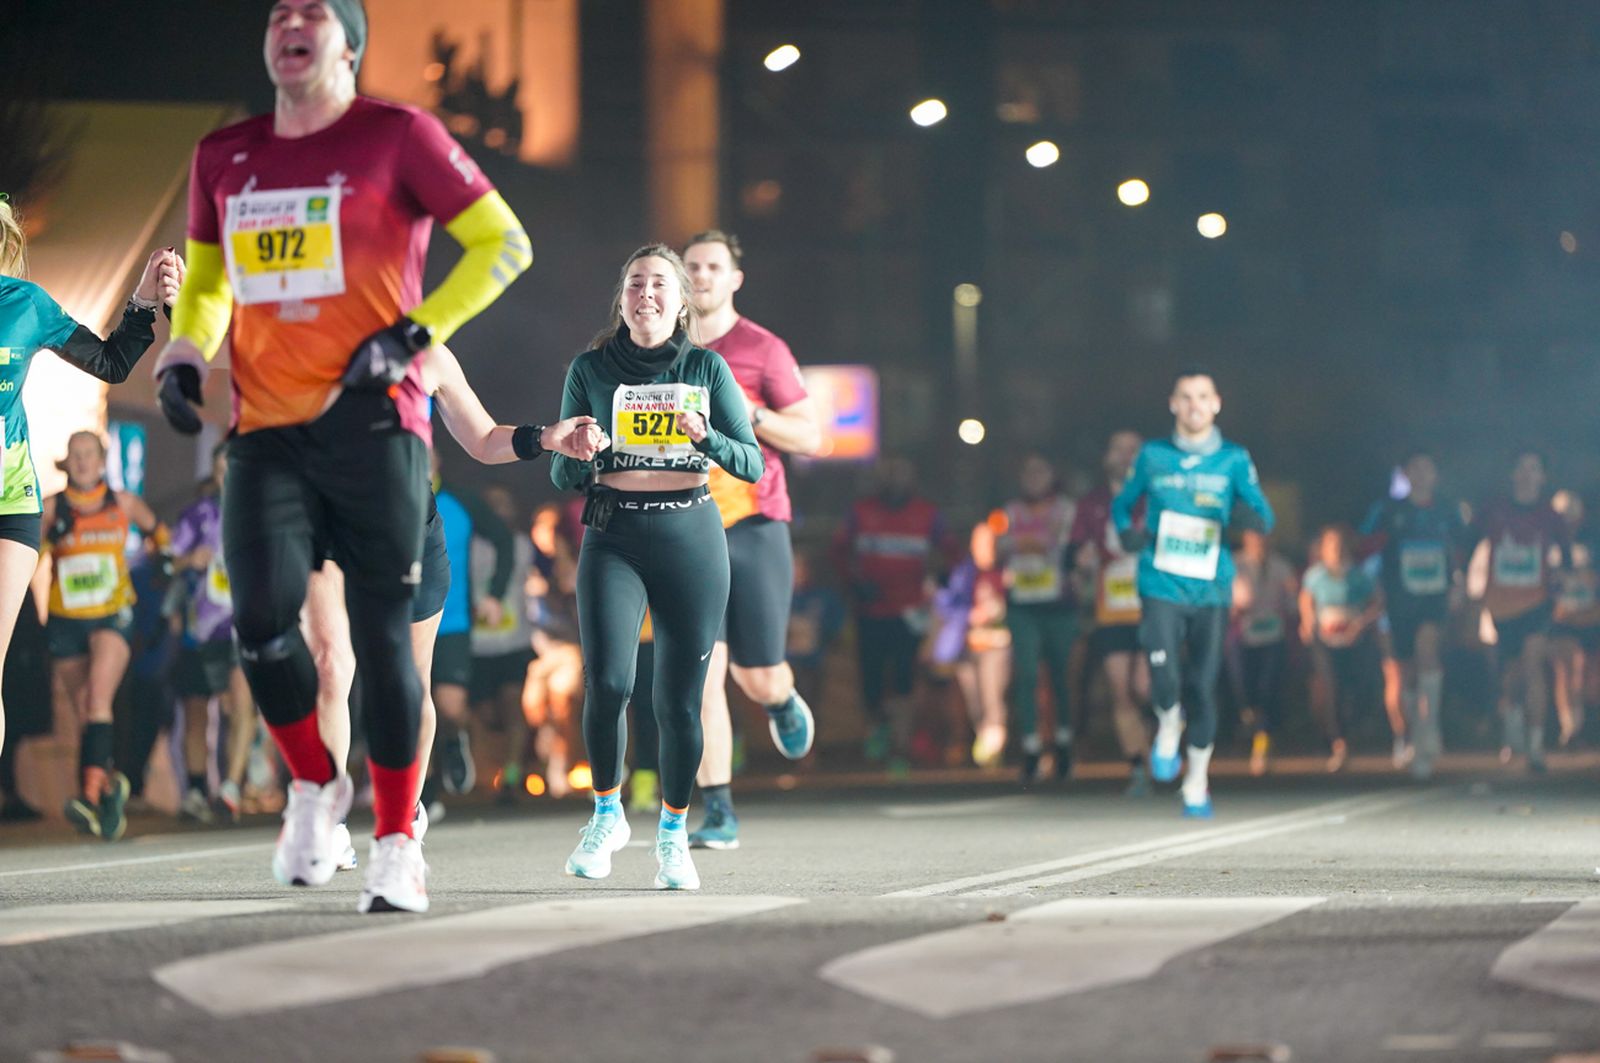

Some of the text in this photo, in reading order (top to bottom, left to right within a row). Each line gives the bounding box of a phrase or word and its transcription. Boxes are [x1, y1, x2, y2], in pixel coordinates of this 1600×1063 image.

[257, 229, 305, 262] 972
[636, 392, 675, 401] NOCHE DE
[624, 403, 643, 411] SAN
[613, 455, 666, 469] NIKE
[670, 455, 710, 470] PRO
